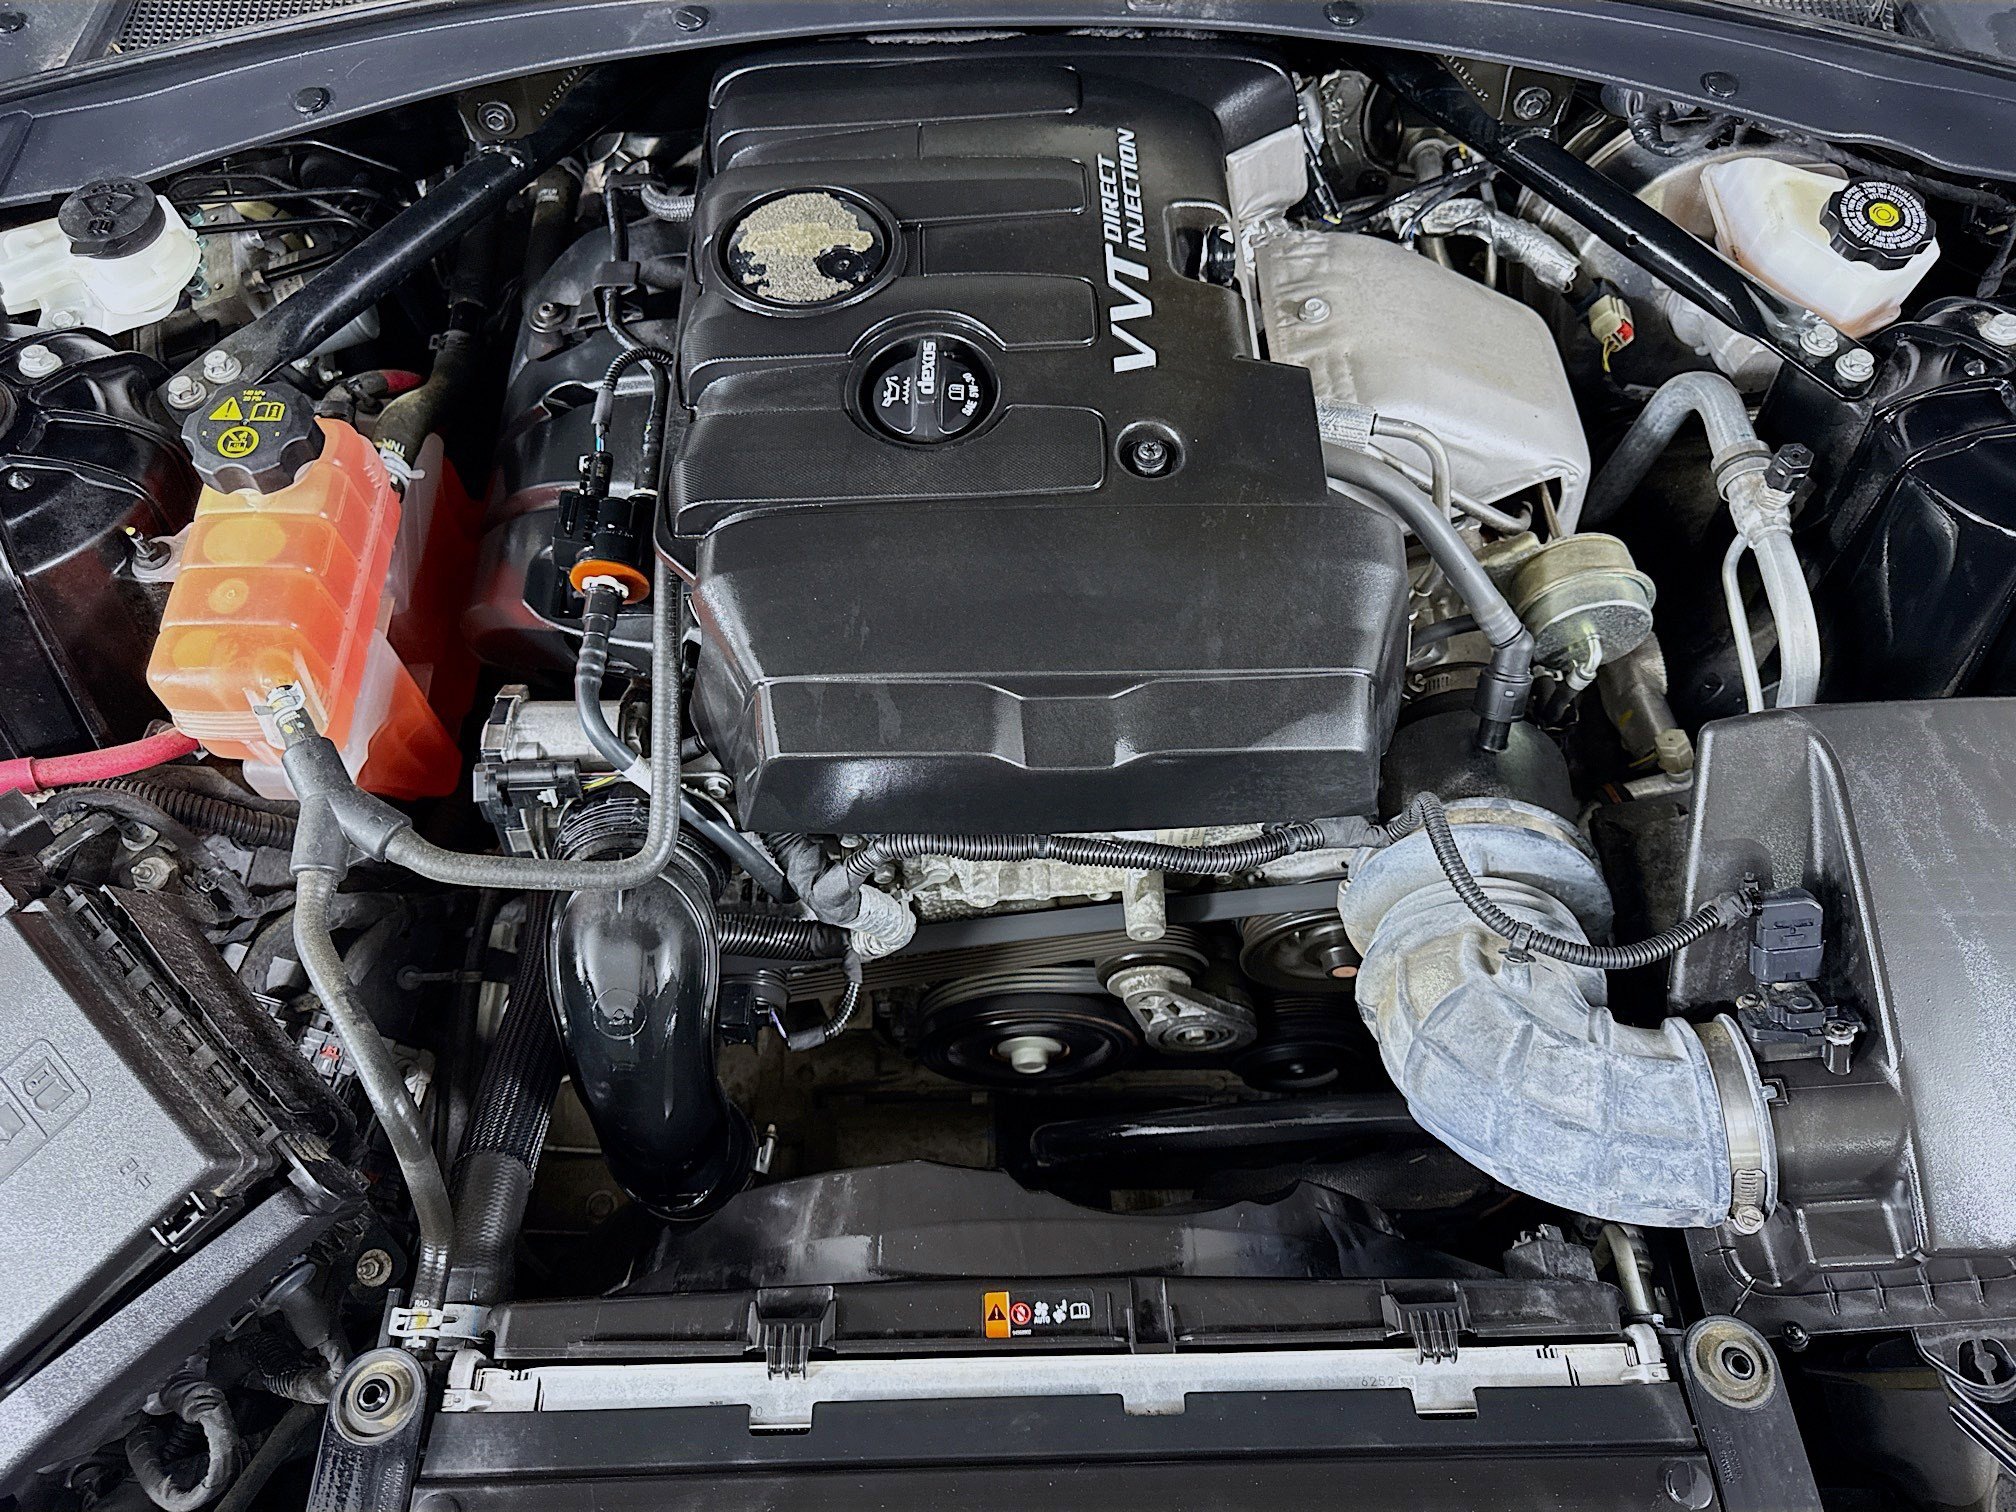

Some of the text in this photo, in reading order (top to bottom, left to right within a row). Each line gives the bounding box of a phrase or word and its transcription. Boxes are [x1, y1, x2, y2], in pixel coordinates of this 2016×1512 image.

[1097, 153, 1123, 244] DIRECT
[1116, 127, 1148, 252] INJECTION
[1104, 242, 1157, 374] VVT
[917, 340, 937, 395] dexos
[961, 372, 980, 417] SAE 5W-30
[414, 1299, 430, 1308] RAD
[1033, 1316, 1051, 1325] AUTO
[1361, 1375, 1395, 1387] 6252
